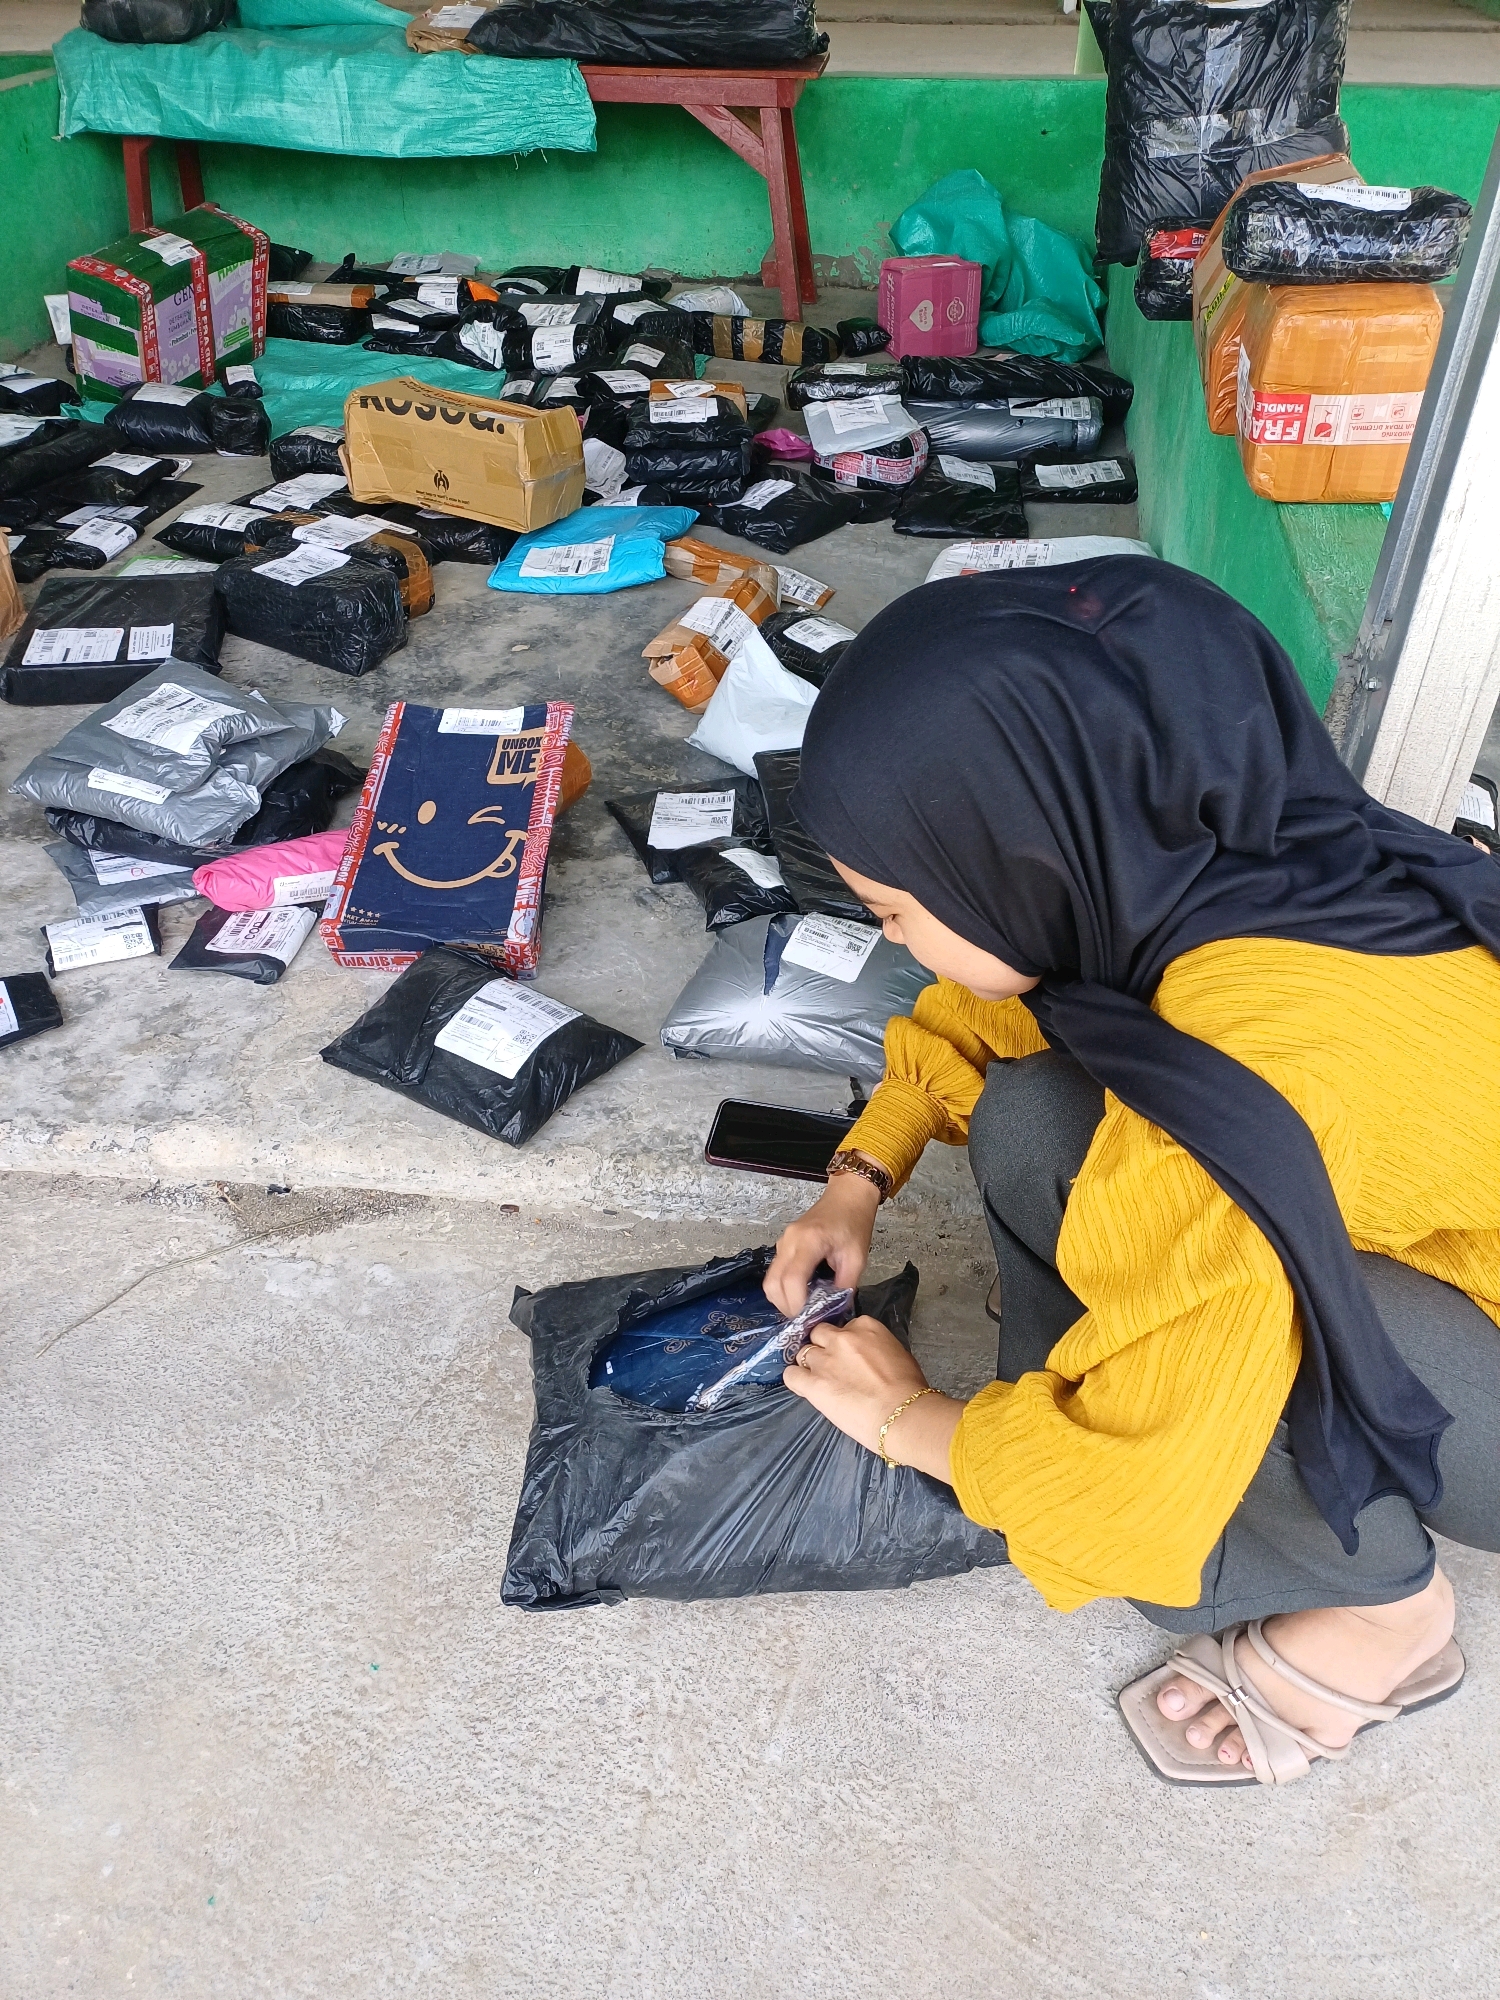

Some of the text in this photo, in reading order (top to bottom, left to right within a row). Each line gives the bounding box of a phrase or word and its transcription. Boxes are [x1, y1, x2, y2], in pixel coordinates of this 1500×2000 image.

[1256, 402, 1304, 413] HANDLE
[1252, 415, 1301, 441] FRA
[502, 736, 542, 750] UNBOX
[496, 750, 539, 775] ME
[341, 956, 391, 967] WAJIB
